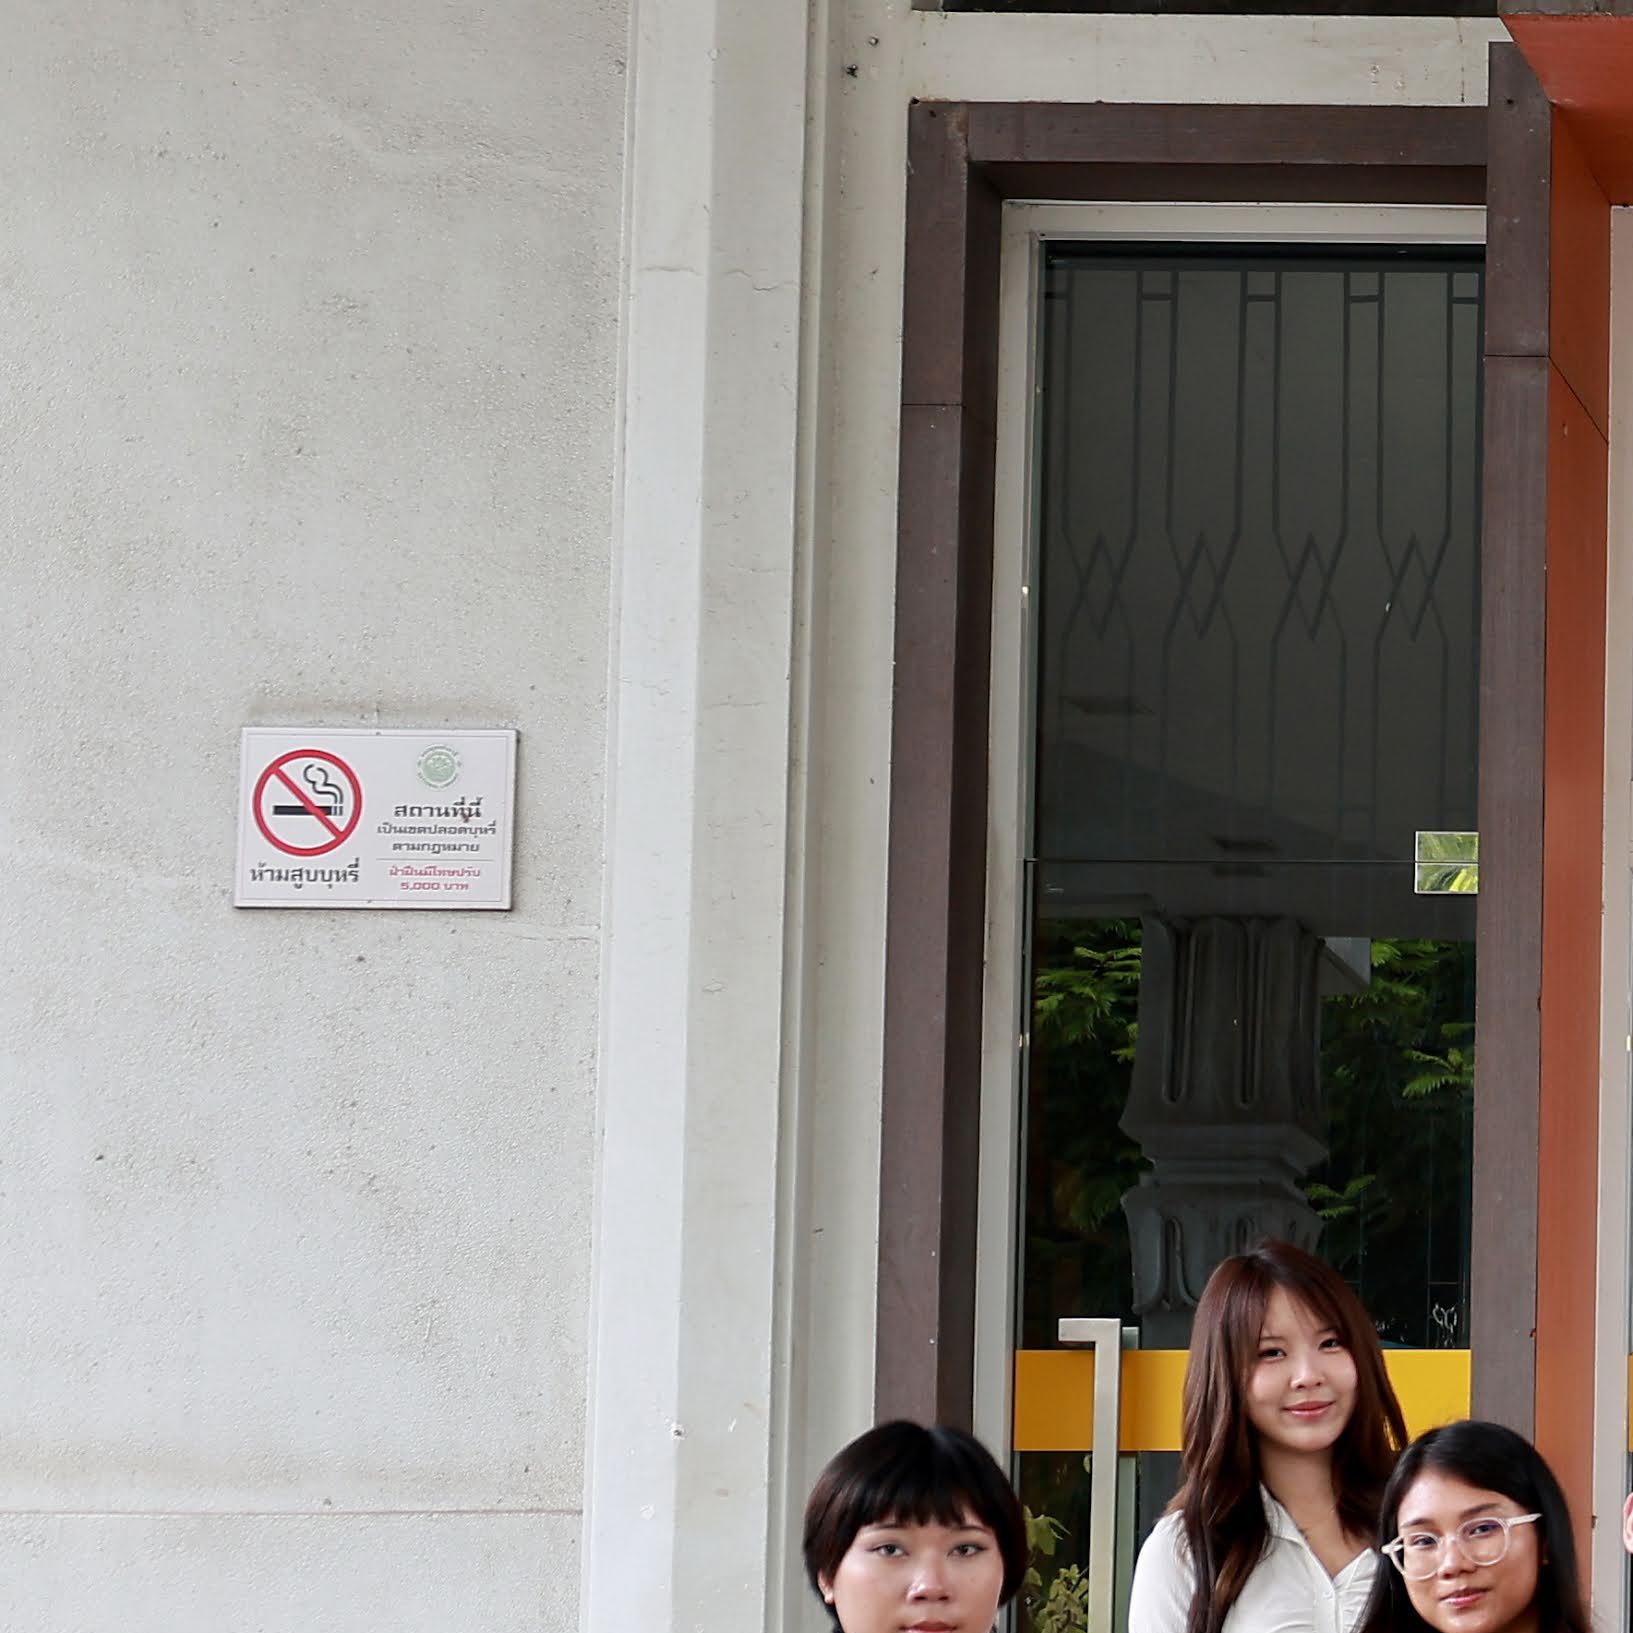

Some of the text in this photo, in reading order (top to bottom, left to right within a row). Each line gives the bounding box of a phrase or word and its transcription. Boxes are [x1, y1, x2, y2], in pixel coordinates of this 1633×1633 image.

[393, 796, 483, 818] สถานที่นี้
[250, 857, 360, 889] ห้ามสูบบุหรี่
